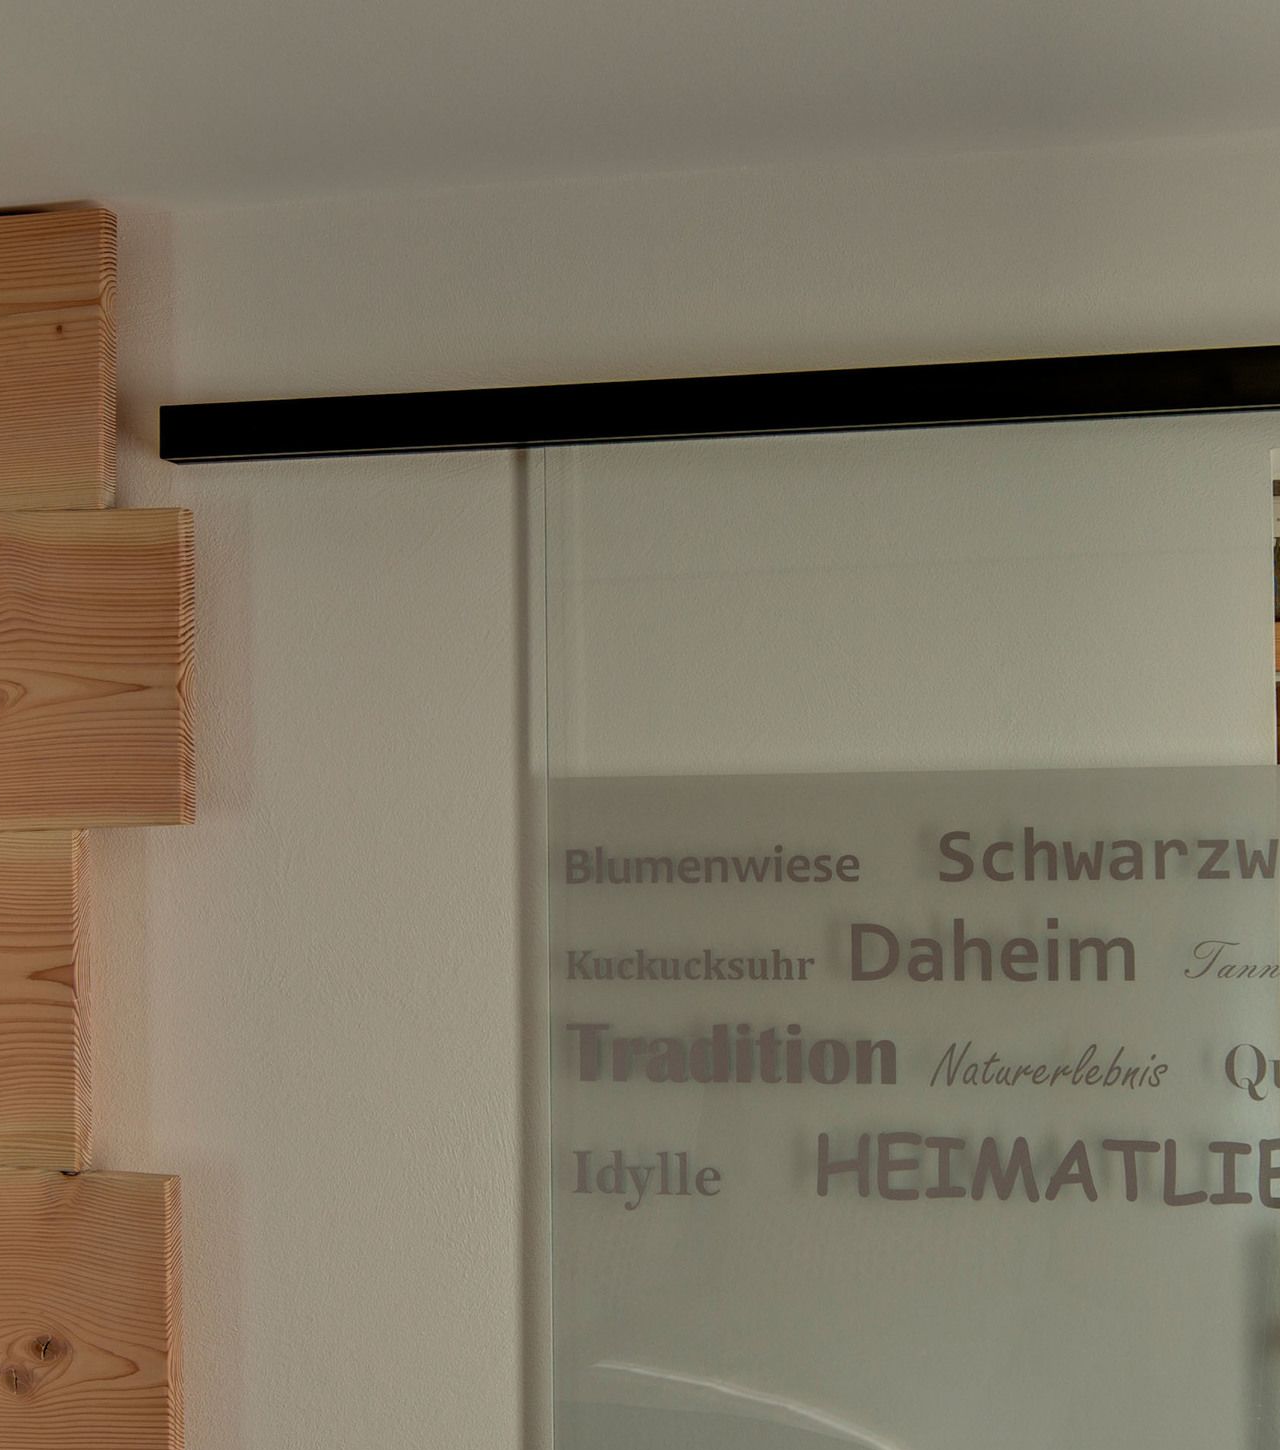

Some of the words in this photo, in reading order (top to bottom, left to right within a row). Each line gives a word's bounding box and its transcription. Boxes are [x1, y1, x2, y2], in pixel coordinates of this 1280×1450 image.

[565, 844, 861, 885] Blumenwiese
[565, 948, 815, 981] Kuckucksuhr
[850, 918, 1136, 982] Daheim
[566, 1023, 898, 1085] Tradition
[929, 1040, 1169, 1089] Naturerlebnis
[572, 1149, 722, 1211] Idylle
